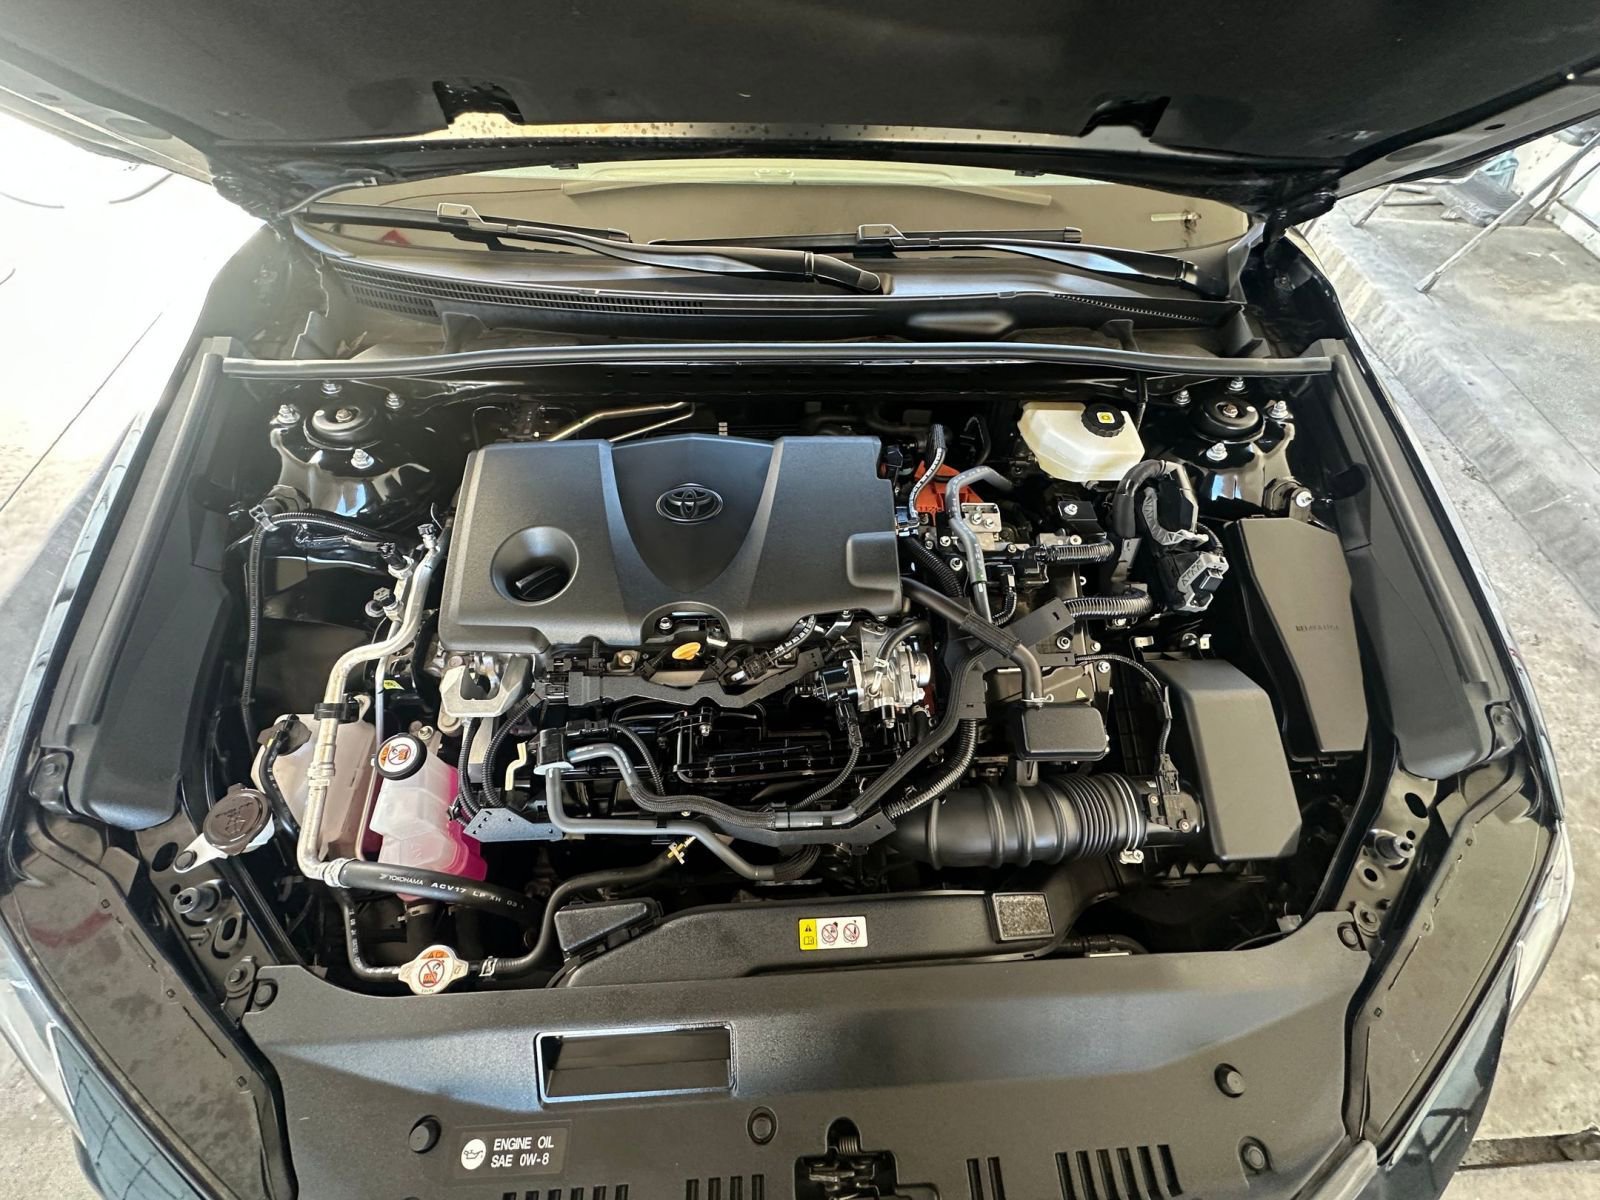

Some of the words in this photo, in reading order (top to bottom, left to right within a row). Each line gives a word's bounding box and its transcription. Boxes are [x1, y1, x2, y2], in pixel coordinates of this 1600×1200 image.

[430, 882, 467, 894] ACV17
[493, 1136, 533, 1151] ENGINE
[537, 1135, 555, 1149] OIL
[490, 1154, 514, 1168] SAE
[519, 1152, 550, 1167] 0W-8
